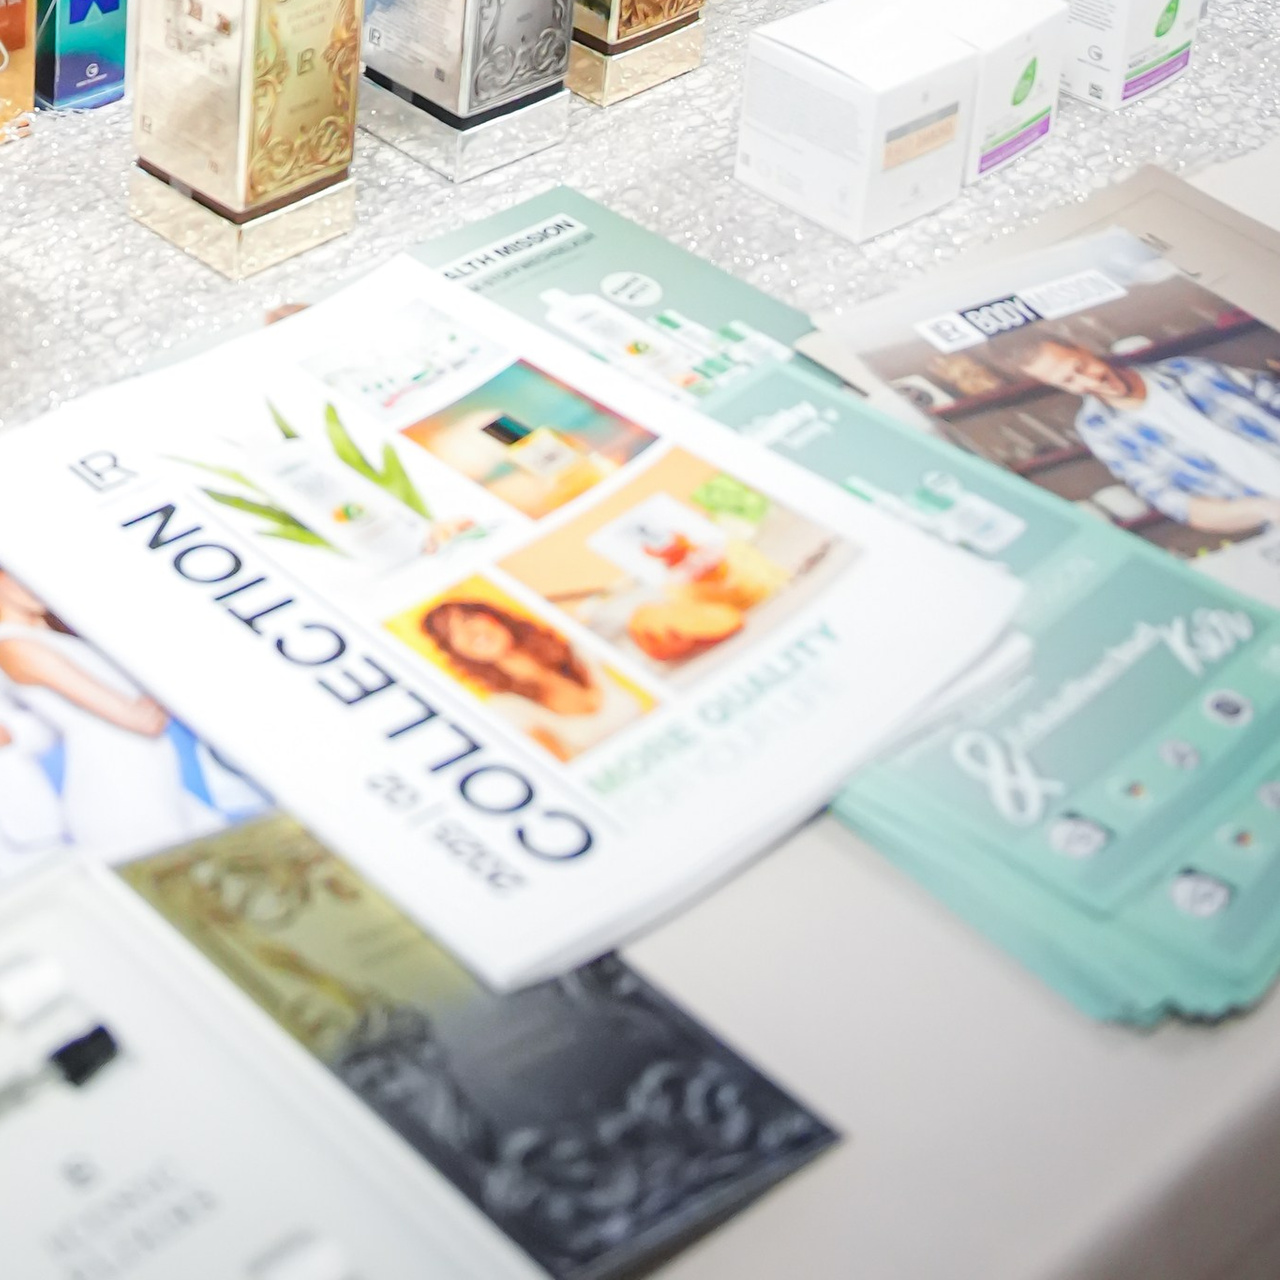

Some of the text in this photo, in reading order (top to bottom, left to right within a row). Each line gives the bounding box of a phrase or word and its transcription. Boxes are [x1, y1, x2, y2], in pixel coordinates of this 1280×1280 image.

[493, 215, 577, 272] MISSION
[964, 296, 1039, 336] BODY
[120, 500, 595, 866] COLLECTION
[705, 616, 843, 734] QUALITY
